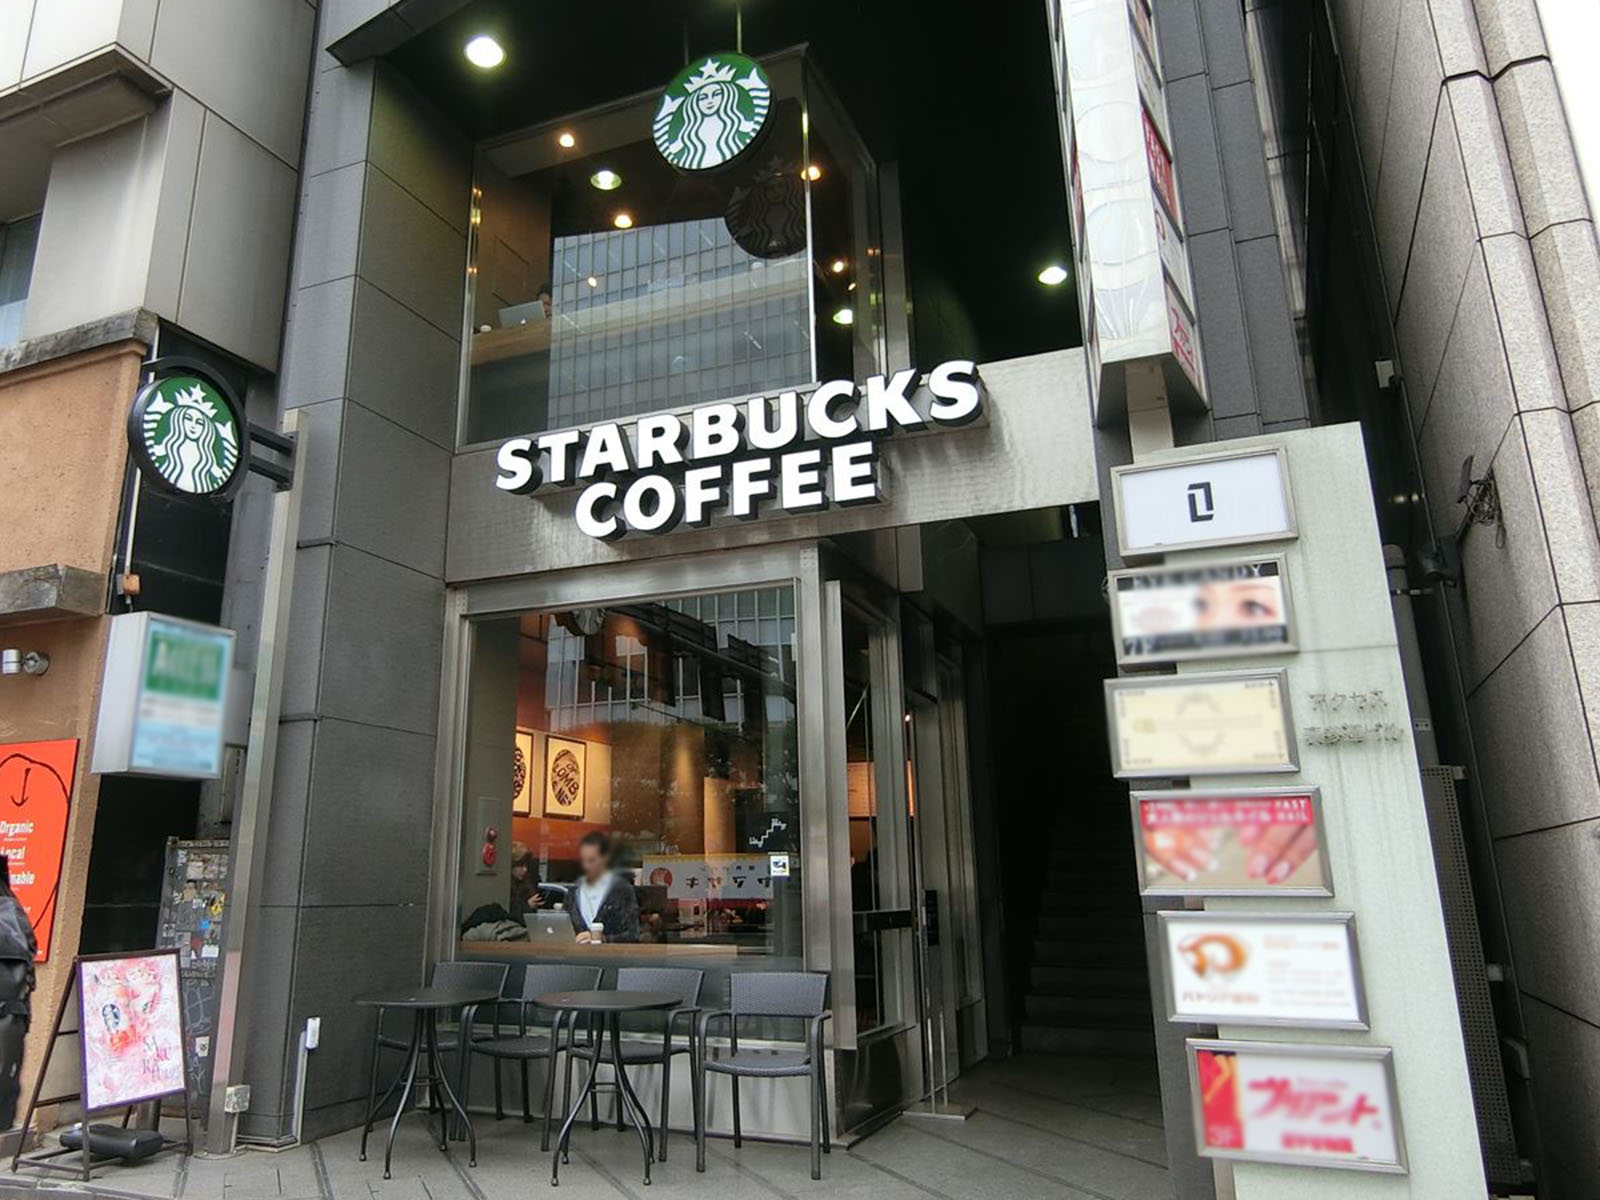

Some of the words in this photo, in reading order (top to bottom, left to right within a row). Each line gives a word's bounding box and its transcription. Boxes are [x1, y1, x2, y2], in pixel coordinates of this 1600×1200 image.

[495, 360, 981, 491] STARBUCKS
[575, 441, 877, 539] COFFEE
[0, 820, 34, 836] Organic
